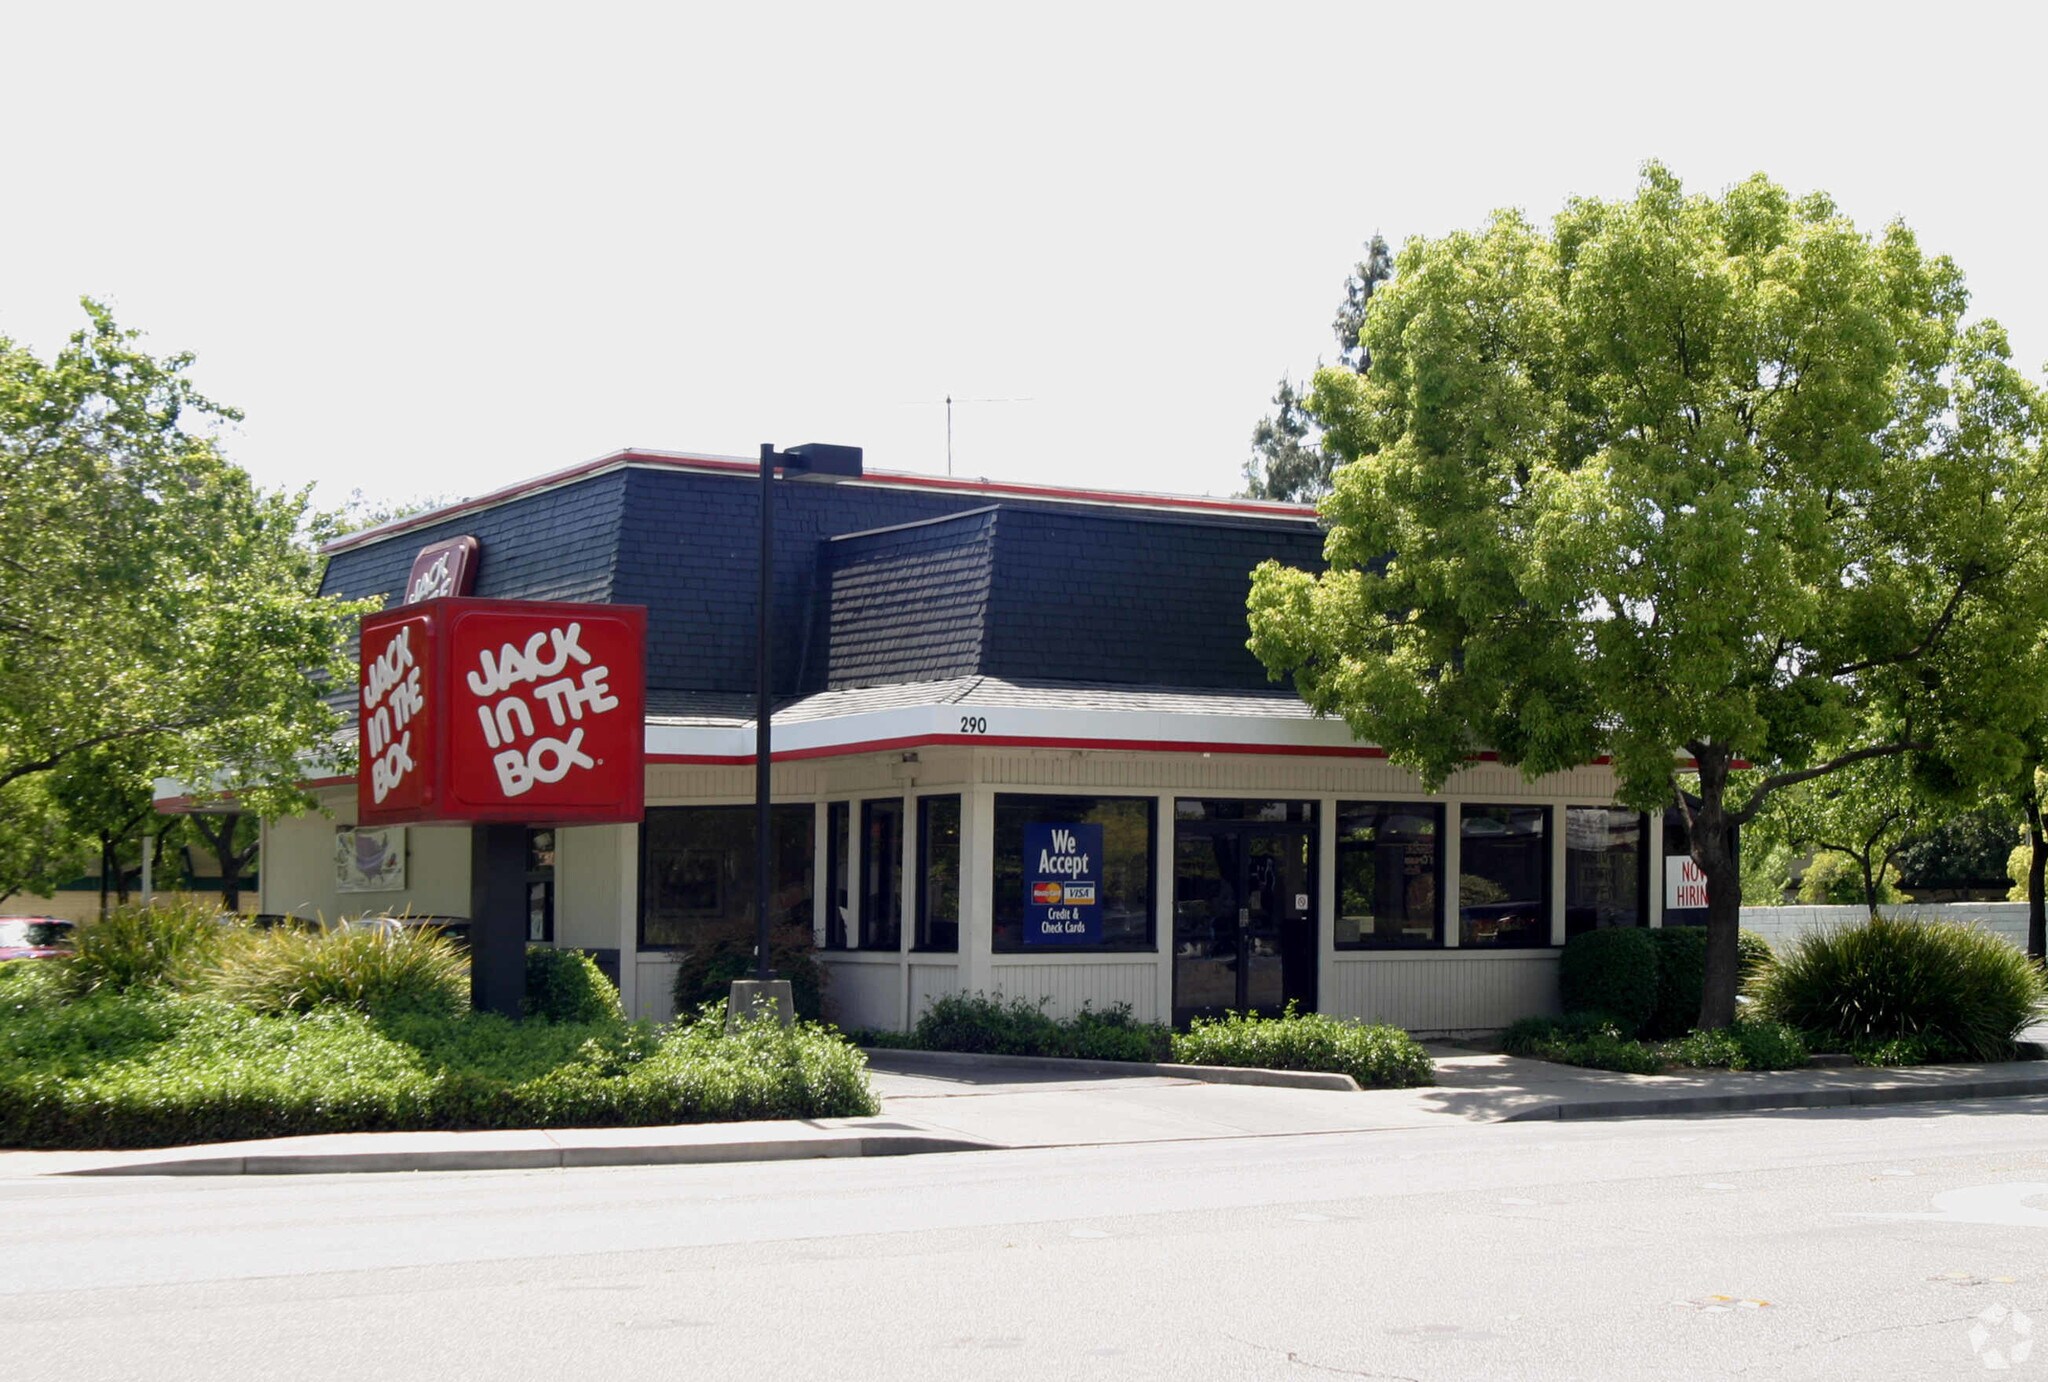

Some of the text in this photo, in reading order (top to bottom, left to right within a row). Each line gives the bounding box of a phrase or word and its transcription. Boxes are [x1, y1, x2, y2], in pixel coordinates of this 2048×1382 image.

[408, 551, 450, 603] JACK
[364, 626, 413, 709] JACK
[467, 622, 591, 697] JACK
[388, 666, 424, 731] THE
[534, 666, 619, 726] THE
[960, 716, 987, 734] 290
[371, 730, 414, 805] BOX
[493, 728, 595, 797] BOX
[1051, 829, 1077, 854] We
[1038, 848, 1090, 880] Accept
[1048, 907, 1080, 920] Credit &
[1069, 888, 1090, 898] VISA
[1677, 885, 1710, 907] HIRIN
[1041, 921, 1086, 934] Check Cards
